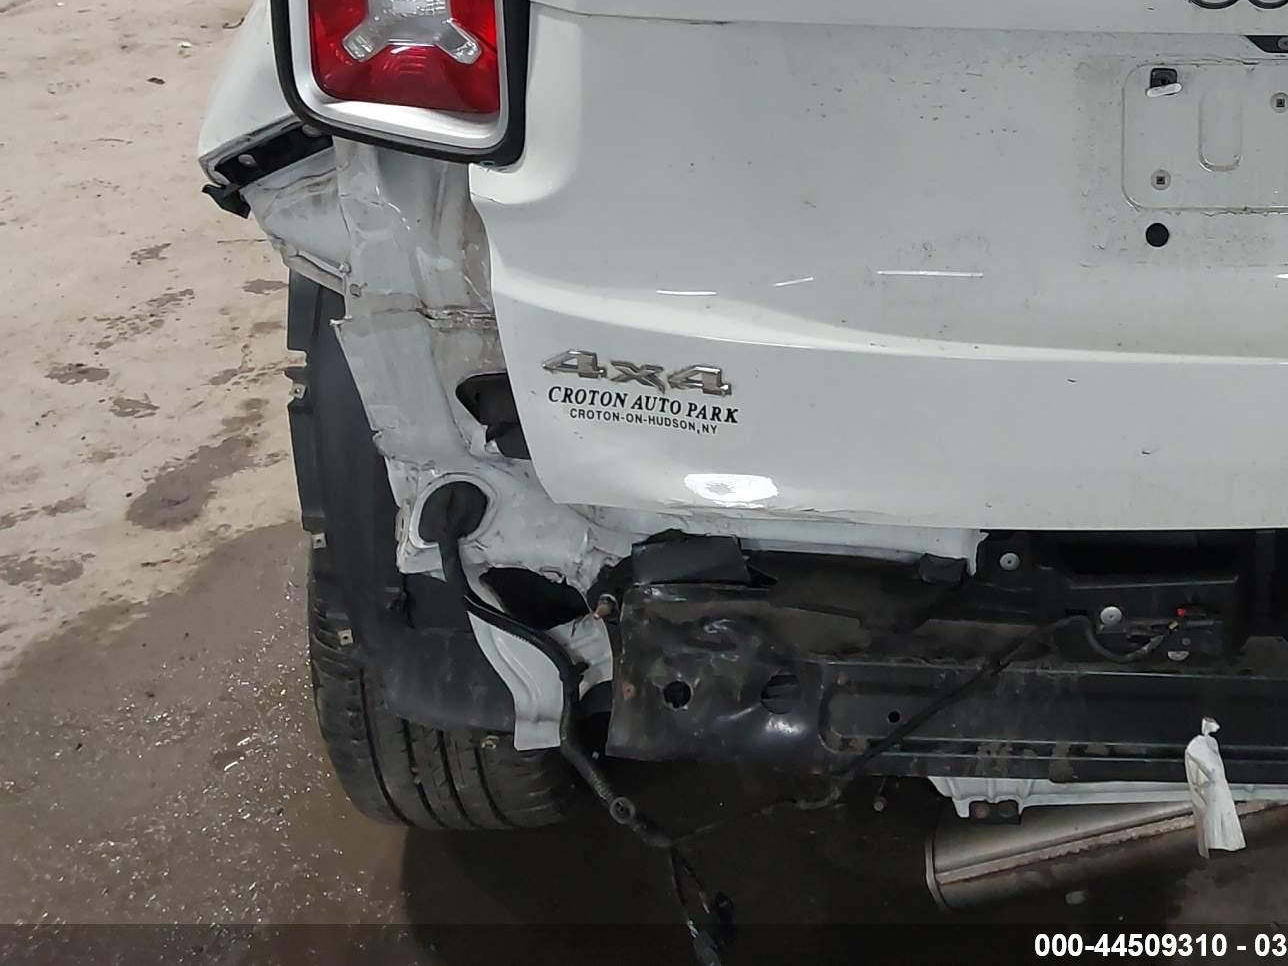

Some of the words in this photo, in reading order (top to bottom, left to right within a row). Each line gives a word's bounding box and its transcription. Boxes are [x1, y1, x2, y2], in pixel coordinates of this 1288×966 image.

[548, 386, 627, 408] CROTON
[630, 395, 682, 415] AUTO
[685, 402, 739, 424] PARK
